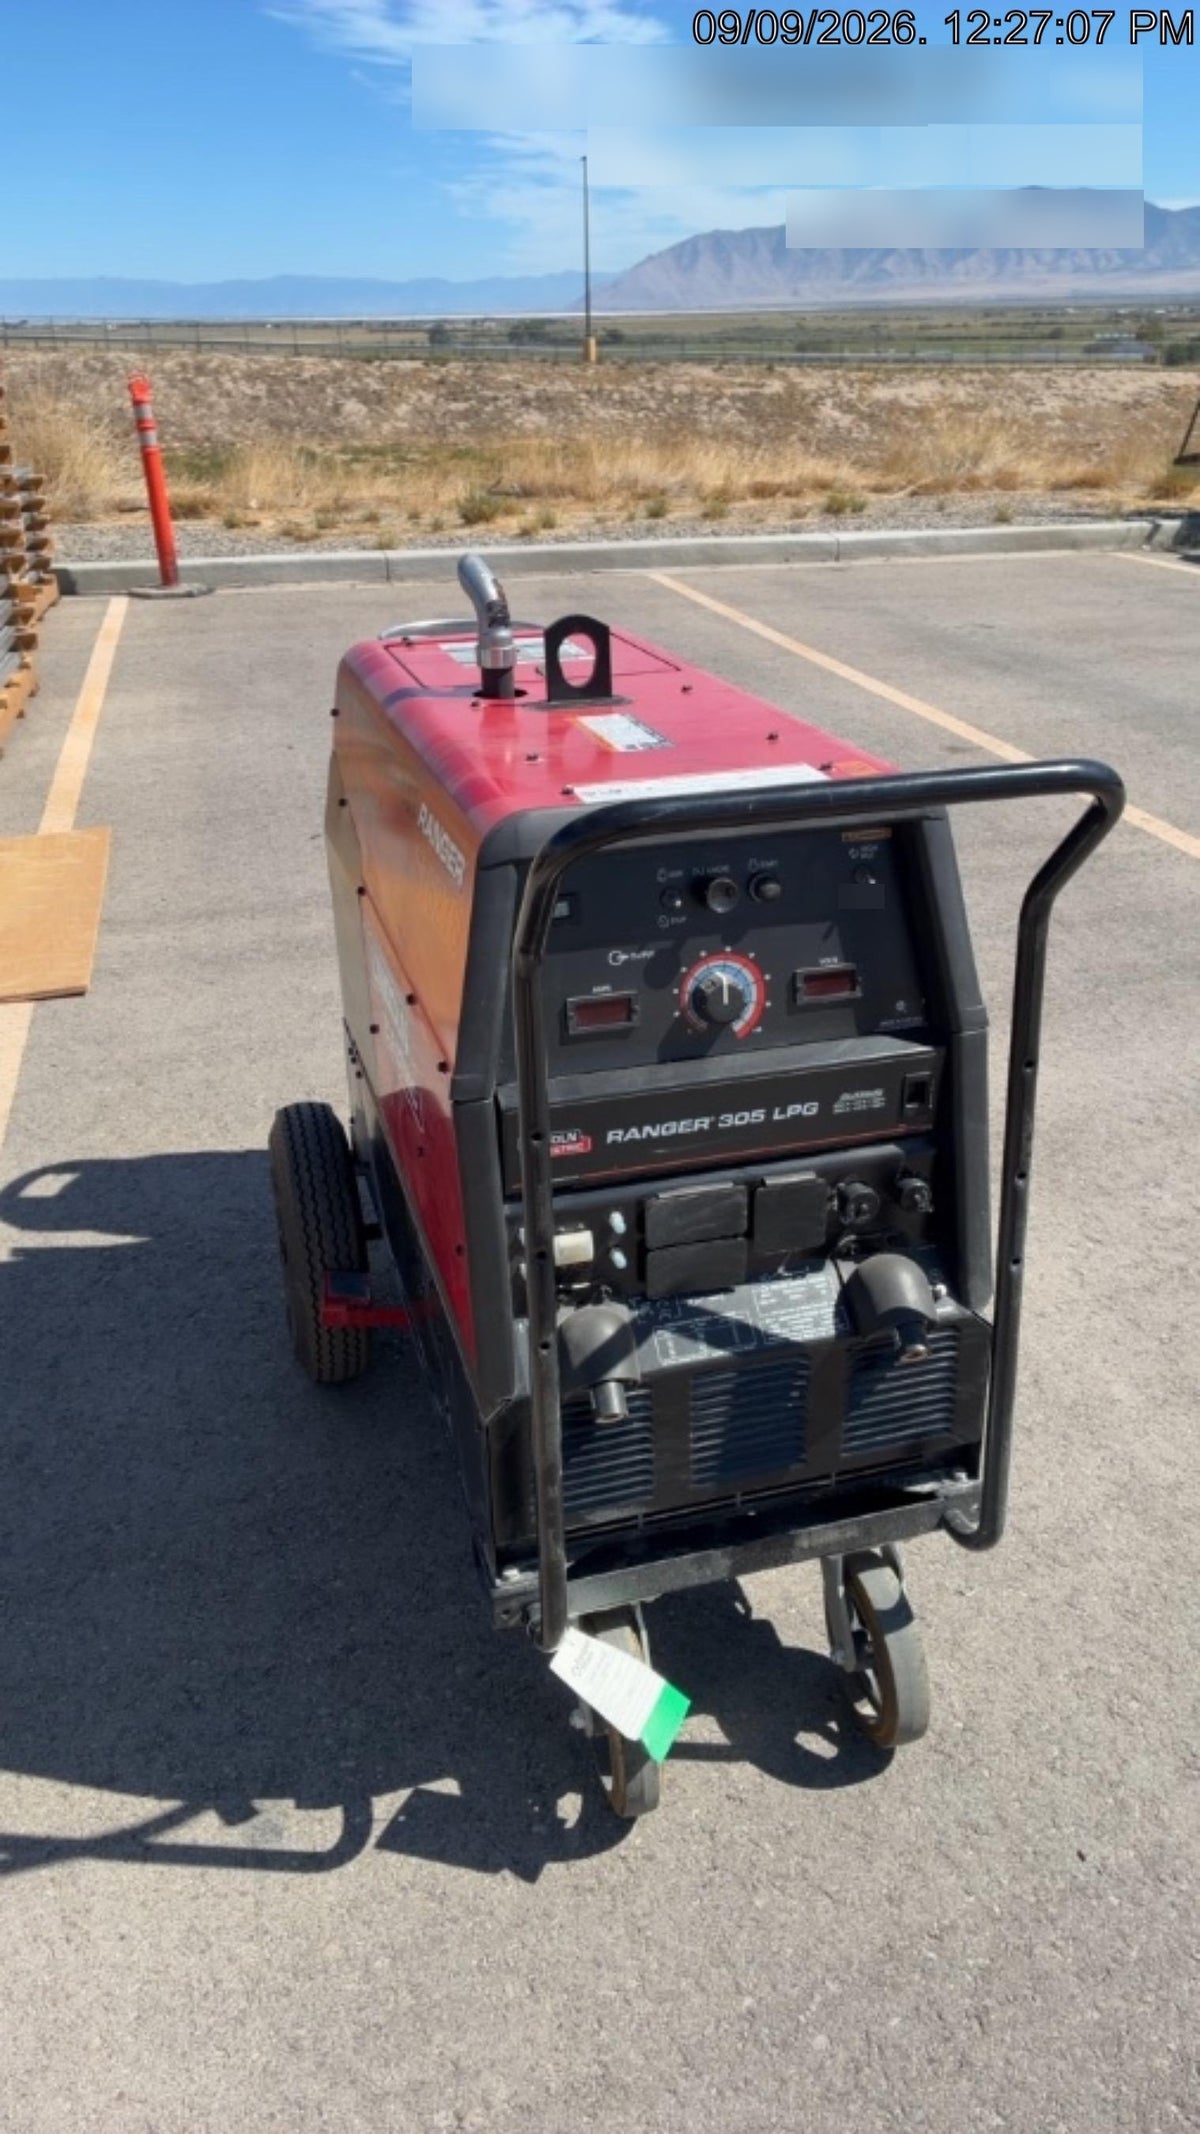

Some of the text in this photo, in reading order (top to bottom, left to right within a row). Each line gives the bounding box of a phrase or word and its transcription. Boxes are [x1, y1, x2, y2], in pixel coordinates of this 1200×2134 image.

[417, 802, 466, 887] RANGER
[606, 1116, 711, 1144] RANGER
[718, 1109, 766, 1128] 305
[773, 1101, 820, 1121] LPG
